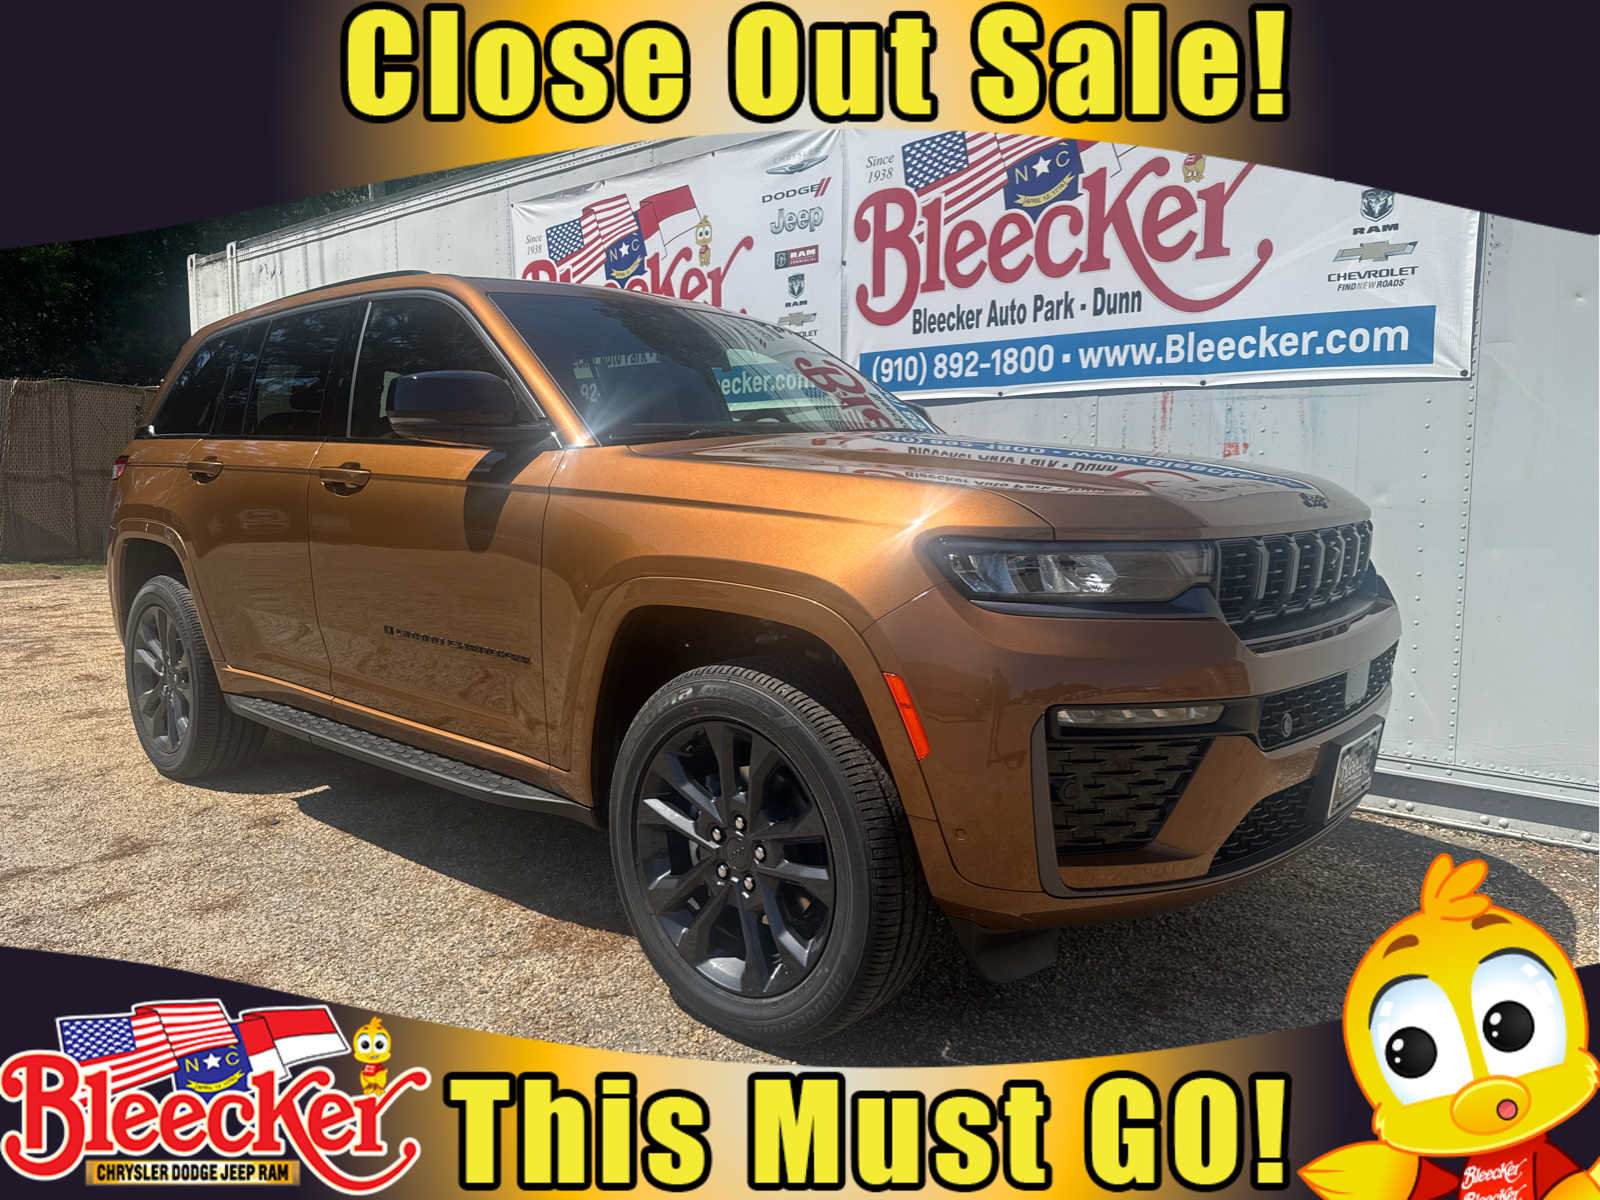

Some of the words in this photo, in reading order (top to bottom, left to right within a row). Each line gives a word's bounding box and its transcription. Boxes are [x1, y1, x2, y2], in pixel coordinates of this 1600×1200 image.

[866, 154, 895, 168] Since
[1014, 164, 1029, 184] N
[1055, 150, 1071, 168] C
[868, 167, 894, 183] 1938
[762, 183, 822, 203] DODGE
[769, 206, 824, 235] Jeep
[1352, 223, 1399, 235] RAM
[854, 156, 1274, 327] Bleecker
[1327, 266, 1419, 282] CHEVROLET
[785, 300, 808, 308] RAM
[912, 304, 983, 334] Bleecker
[986, 299, 1027, 328] Auto
[1032, 291, 1075, 323] Park
[1092, 287, 1142, 316] Dunn
[872, 351, 928, 386] (910)
[933, 344, 1055, 379] 892-1800
[1078, 324, 1409, 369] www.Bleecker.com
